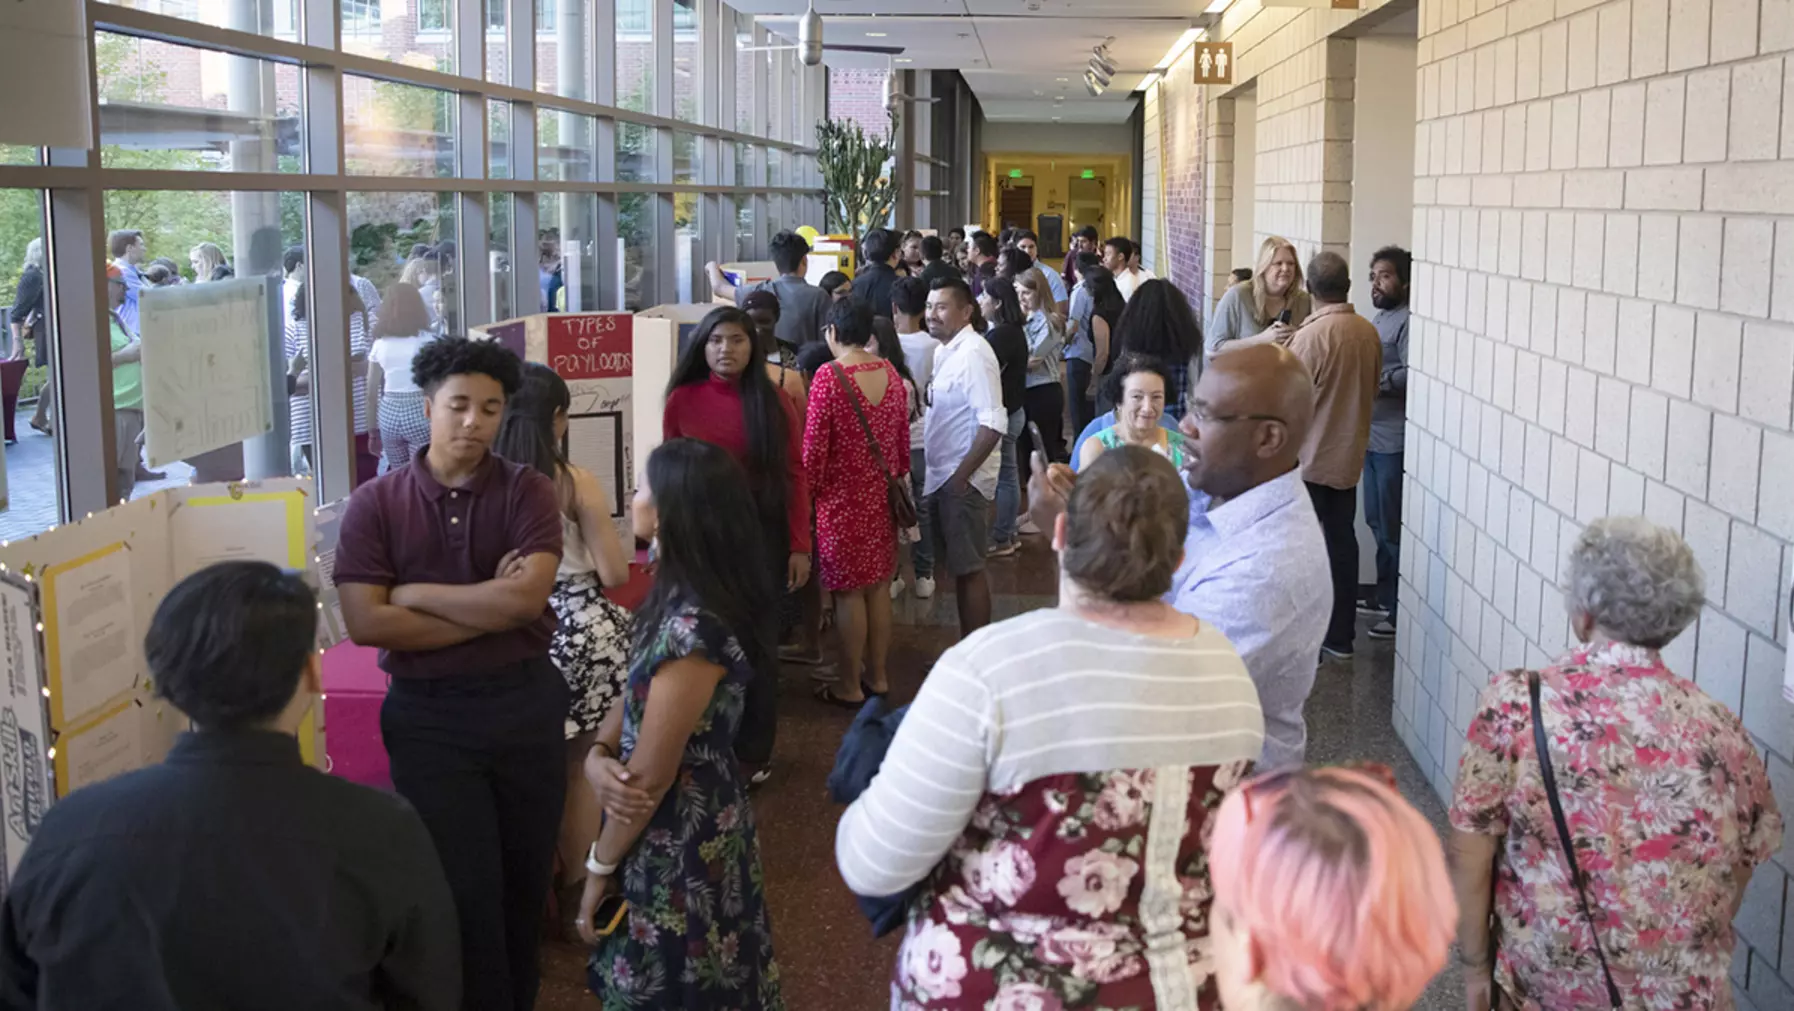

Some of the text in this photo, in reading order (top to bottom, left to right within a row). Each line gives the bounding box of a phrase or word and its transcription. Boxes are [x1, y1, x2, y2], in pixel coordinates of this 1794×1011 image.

[562, 316, 616, 334] TYPES
[577, 336, 603, 350] OF
[1, 706, 30, 841] ArtSkills
